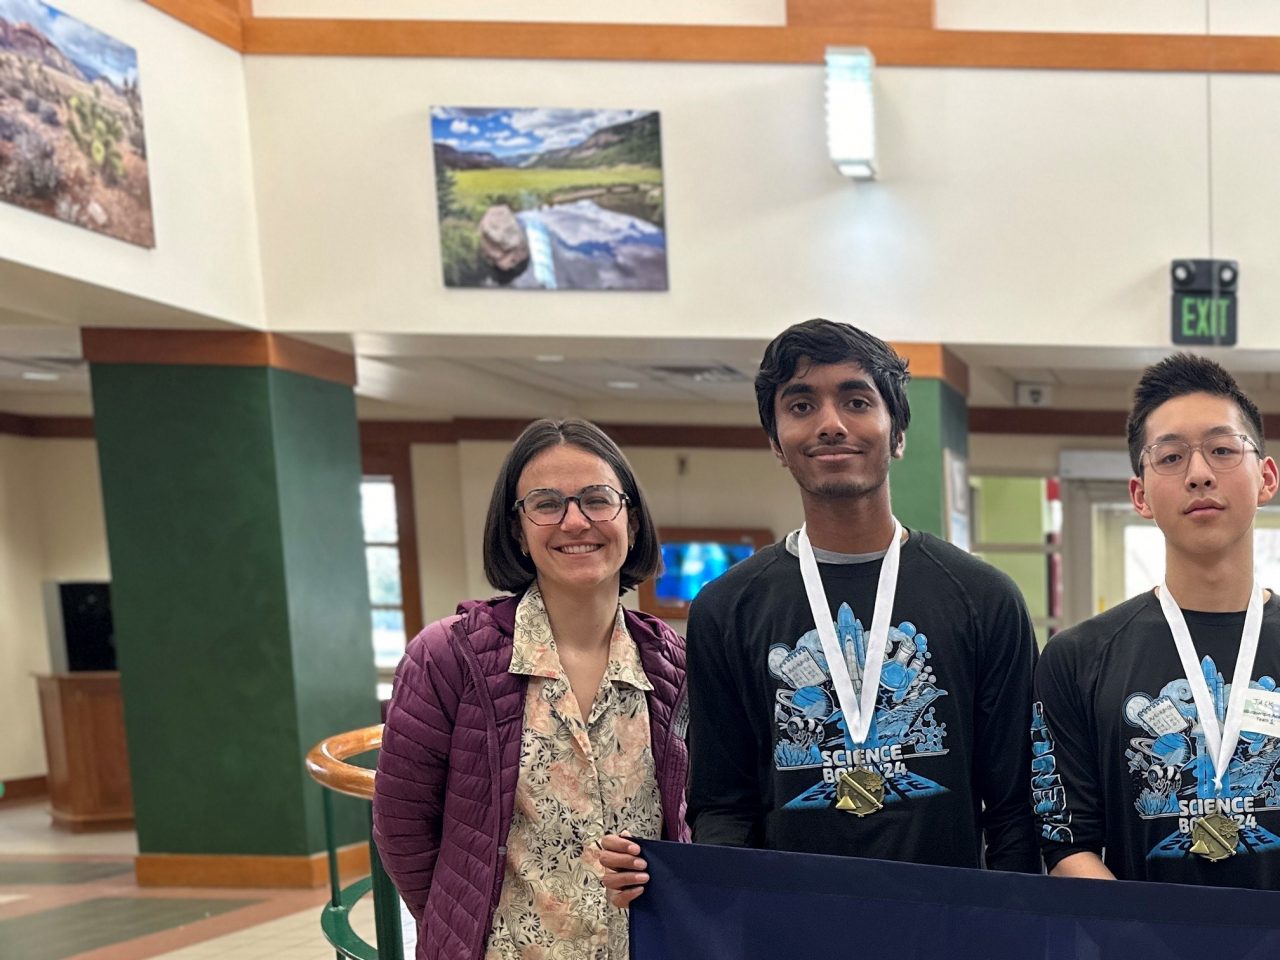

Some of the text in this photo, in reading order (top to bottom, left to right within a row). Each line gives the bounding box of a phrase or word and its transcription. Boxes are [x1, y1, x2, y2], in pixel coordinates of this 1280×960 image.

[1182, 296, 1230, 336] EXIT
[821, 744, 904, 767] SCIENCE
[880, 761, 907, 778] '24
[1178, 796, 1255, 817] SCIENCE
